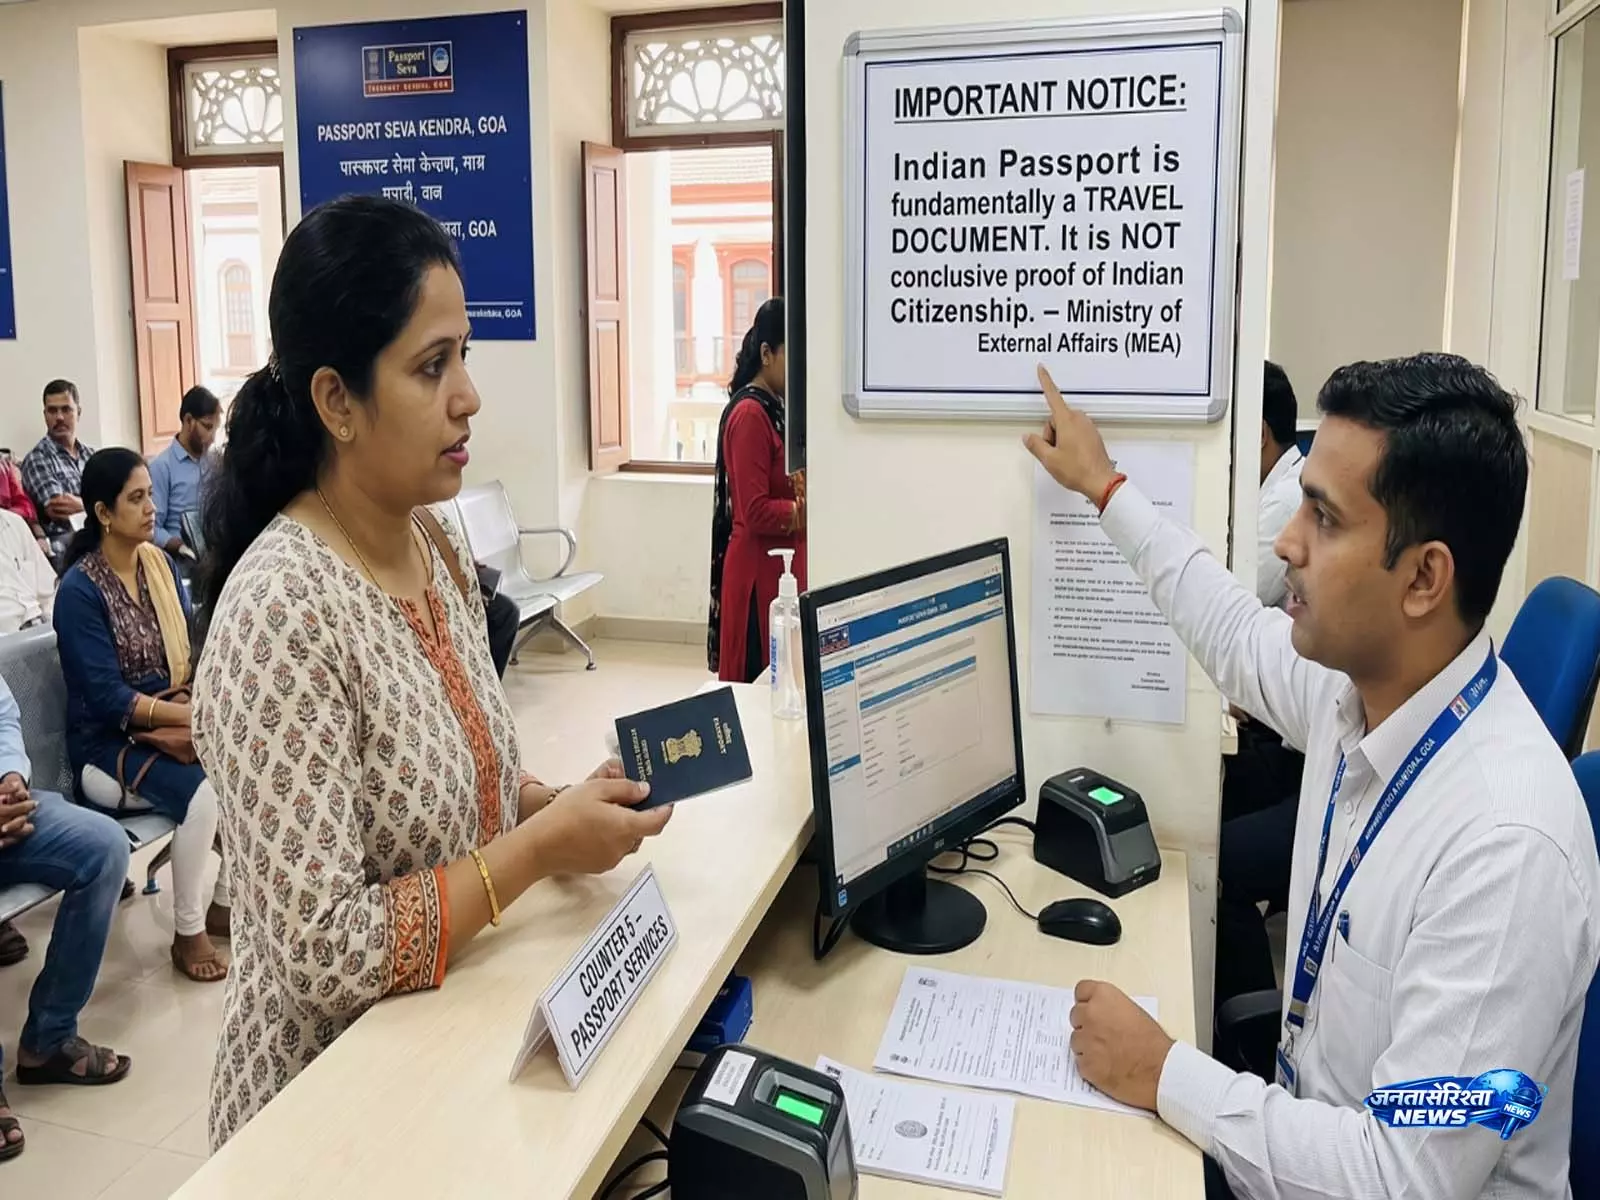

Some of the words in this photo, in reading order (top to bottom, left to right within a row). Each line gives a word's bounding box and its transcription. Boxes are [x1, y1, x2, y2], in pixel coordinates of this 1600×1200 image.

[387, 49, 426, 64] Passport
[895, 81, 1058, 119] IMPORTANT
[1067, 74, 1187, 111] NOTICE:
[317, 122, 382, 142] PASSPORT
[384, 120, 417, 139] SEVA
[419, 118, 475, 138] KENDRA,
[477, 115, 508, 134] GOA
[894, 151, 986, 181] Indian
[999, 146, 1141, 183] Passport
[1153, 143, 1180, 173] is
[891, 188, 1055, 220] fundamentally
[1062, 193, 1076, 213] a
[1083, 184, 1184, 212] TRAVEL
[468, 219, 498, 238] GOA
[892, 225, 1050, 254] DOCUMENT.
[1061, 224, 1078, 251] It
[1088, 223, 1110, 251] is
[1121, 221, 1181, 250] NOT
[890, 263, 1008, 289] conclusive
[1015, 261, 1077, 293] proof
[1082, 261, 1106, 286] of
[1112, 260, 1184, 286] Indian
[890, 297, 1035, 329] Citizenship.
[1067, 299, 1153, 329] Ministry
[1160, 298, 1183, 323] of
[978, 332, 1052, 353] External
[1056, 332, 1119, 353] Affairs
[1124, 332, 1181, 358] (MEA)
[1419, 738, 1436, 757] GOA
[579, 925, 629, 998] COUNTER
[625, 915, 636, 938] 5
[570, 970, 627, 1058] PASSPORT
[623, 914, 669, 983] SERVICES
